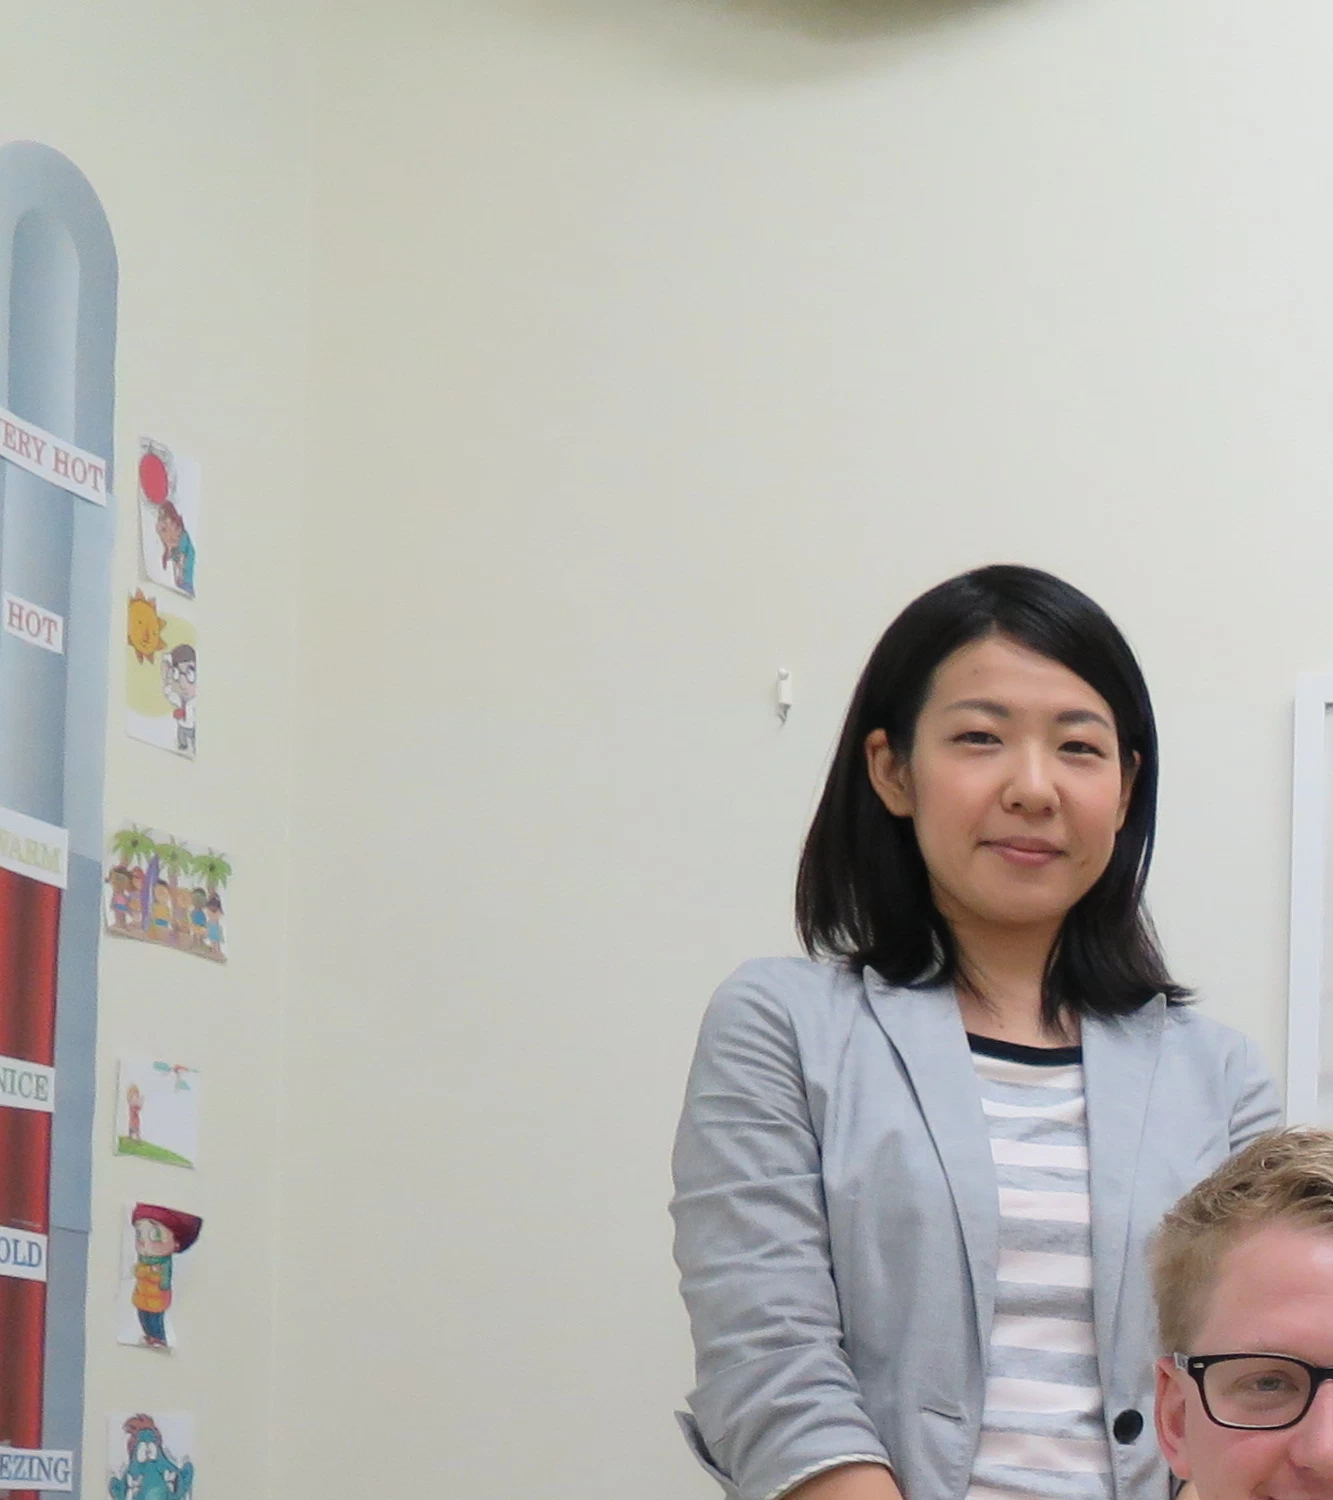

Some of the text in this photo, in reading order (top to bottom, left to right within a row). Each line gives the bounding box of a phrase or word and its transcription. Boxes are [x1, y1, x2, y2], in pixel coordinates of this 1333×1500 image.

[0, 418, 104, 493] ERY HOT
[8, 600, 58, 647] HOT
